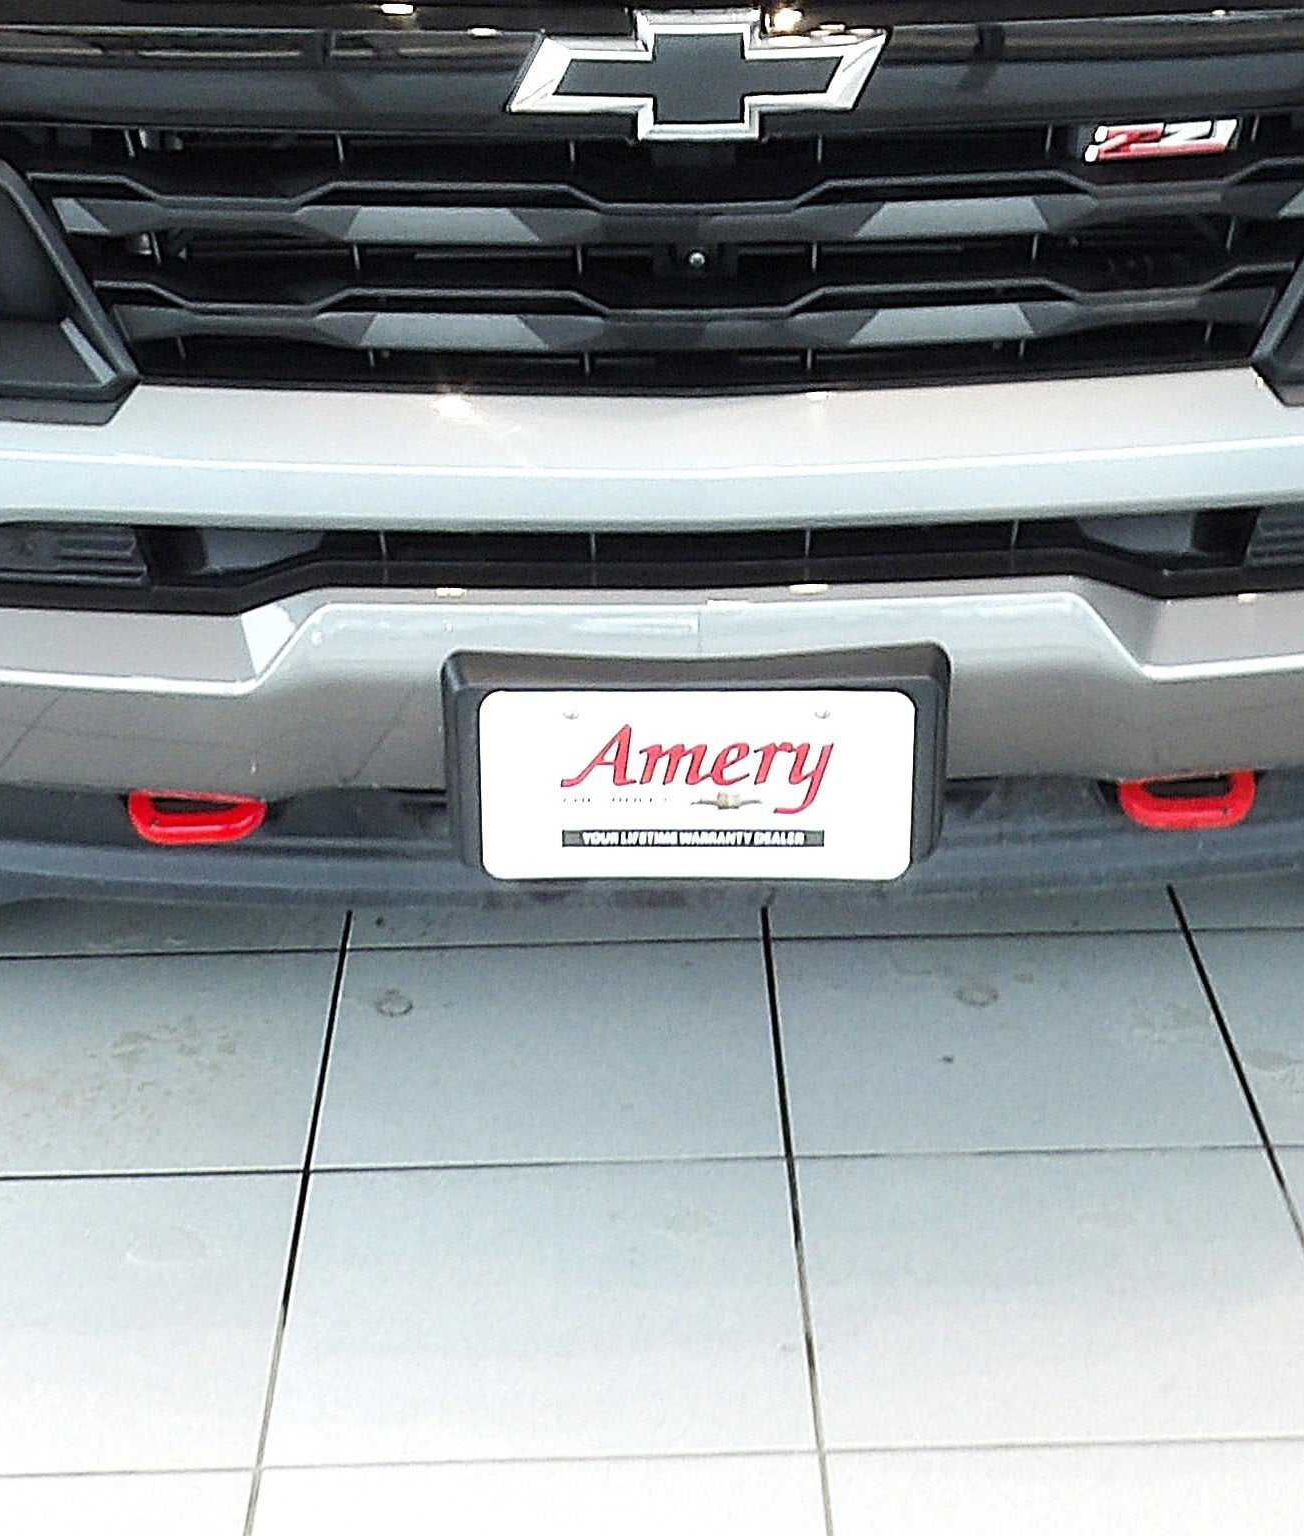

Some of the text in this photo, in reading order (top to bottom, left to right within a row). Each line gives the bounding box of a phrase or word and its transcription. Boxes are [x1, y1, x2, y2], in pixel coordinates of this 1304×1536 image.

[560, 723, 834, 814] Amery
[582, 831, 805, 846] YOUR LIFETIME WARRANTY DEALER
